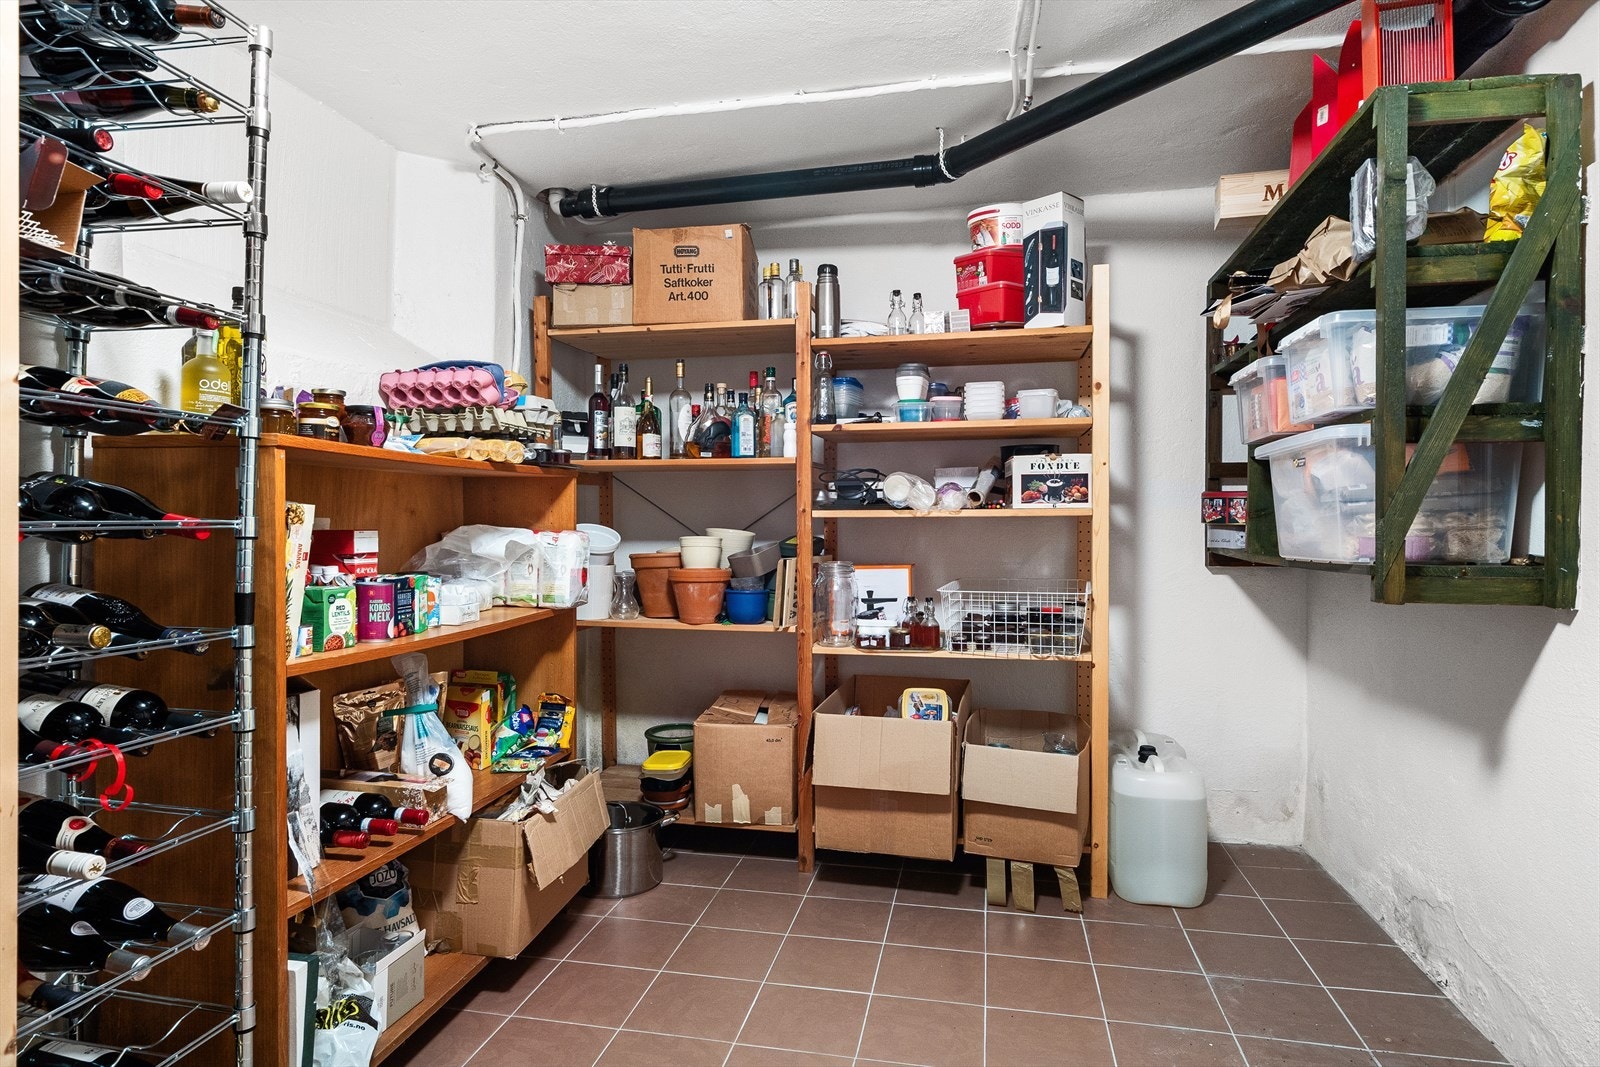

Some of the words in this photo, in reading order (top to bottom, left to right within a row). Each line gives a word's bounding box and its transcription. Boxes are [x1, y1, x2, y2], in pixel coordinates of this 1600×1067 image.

[1025, 201, 1061, 217] VINKASSE
[1001, 222, 1021, 230] SODD
[664, 277, 713, 288] Saftkoker
[1030, 461, 1080, 470] FONDUE
[295, 543, 303, 570] ANANAS
[368, 602, 391, 612] KOKOS
[368, 612, 391, 622] MELK
[371, 868, 397, 885] JOZO
[383, 913, 417, 933] HAVSALT
[343, 1021, 366, 1031] ris.no
